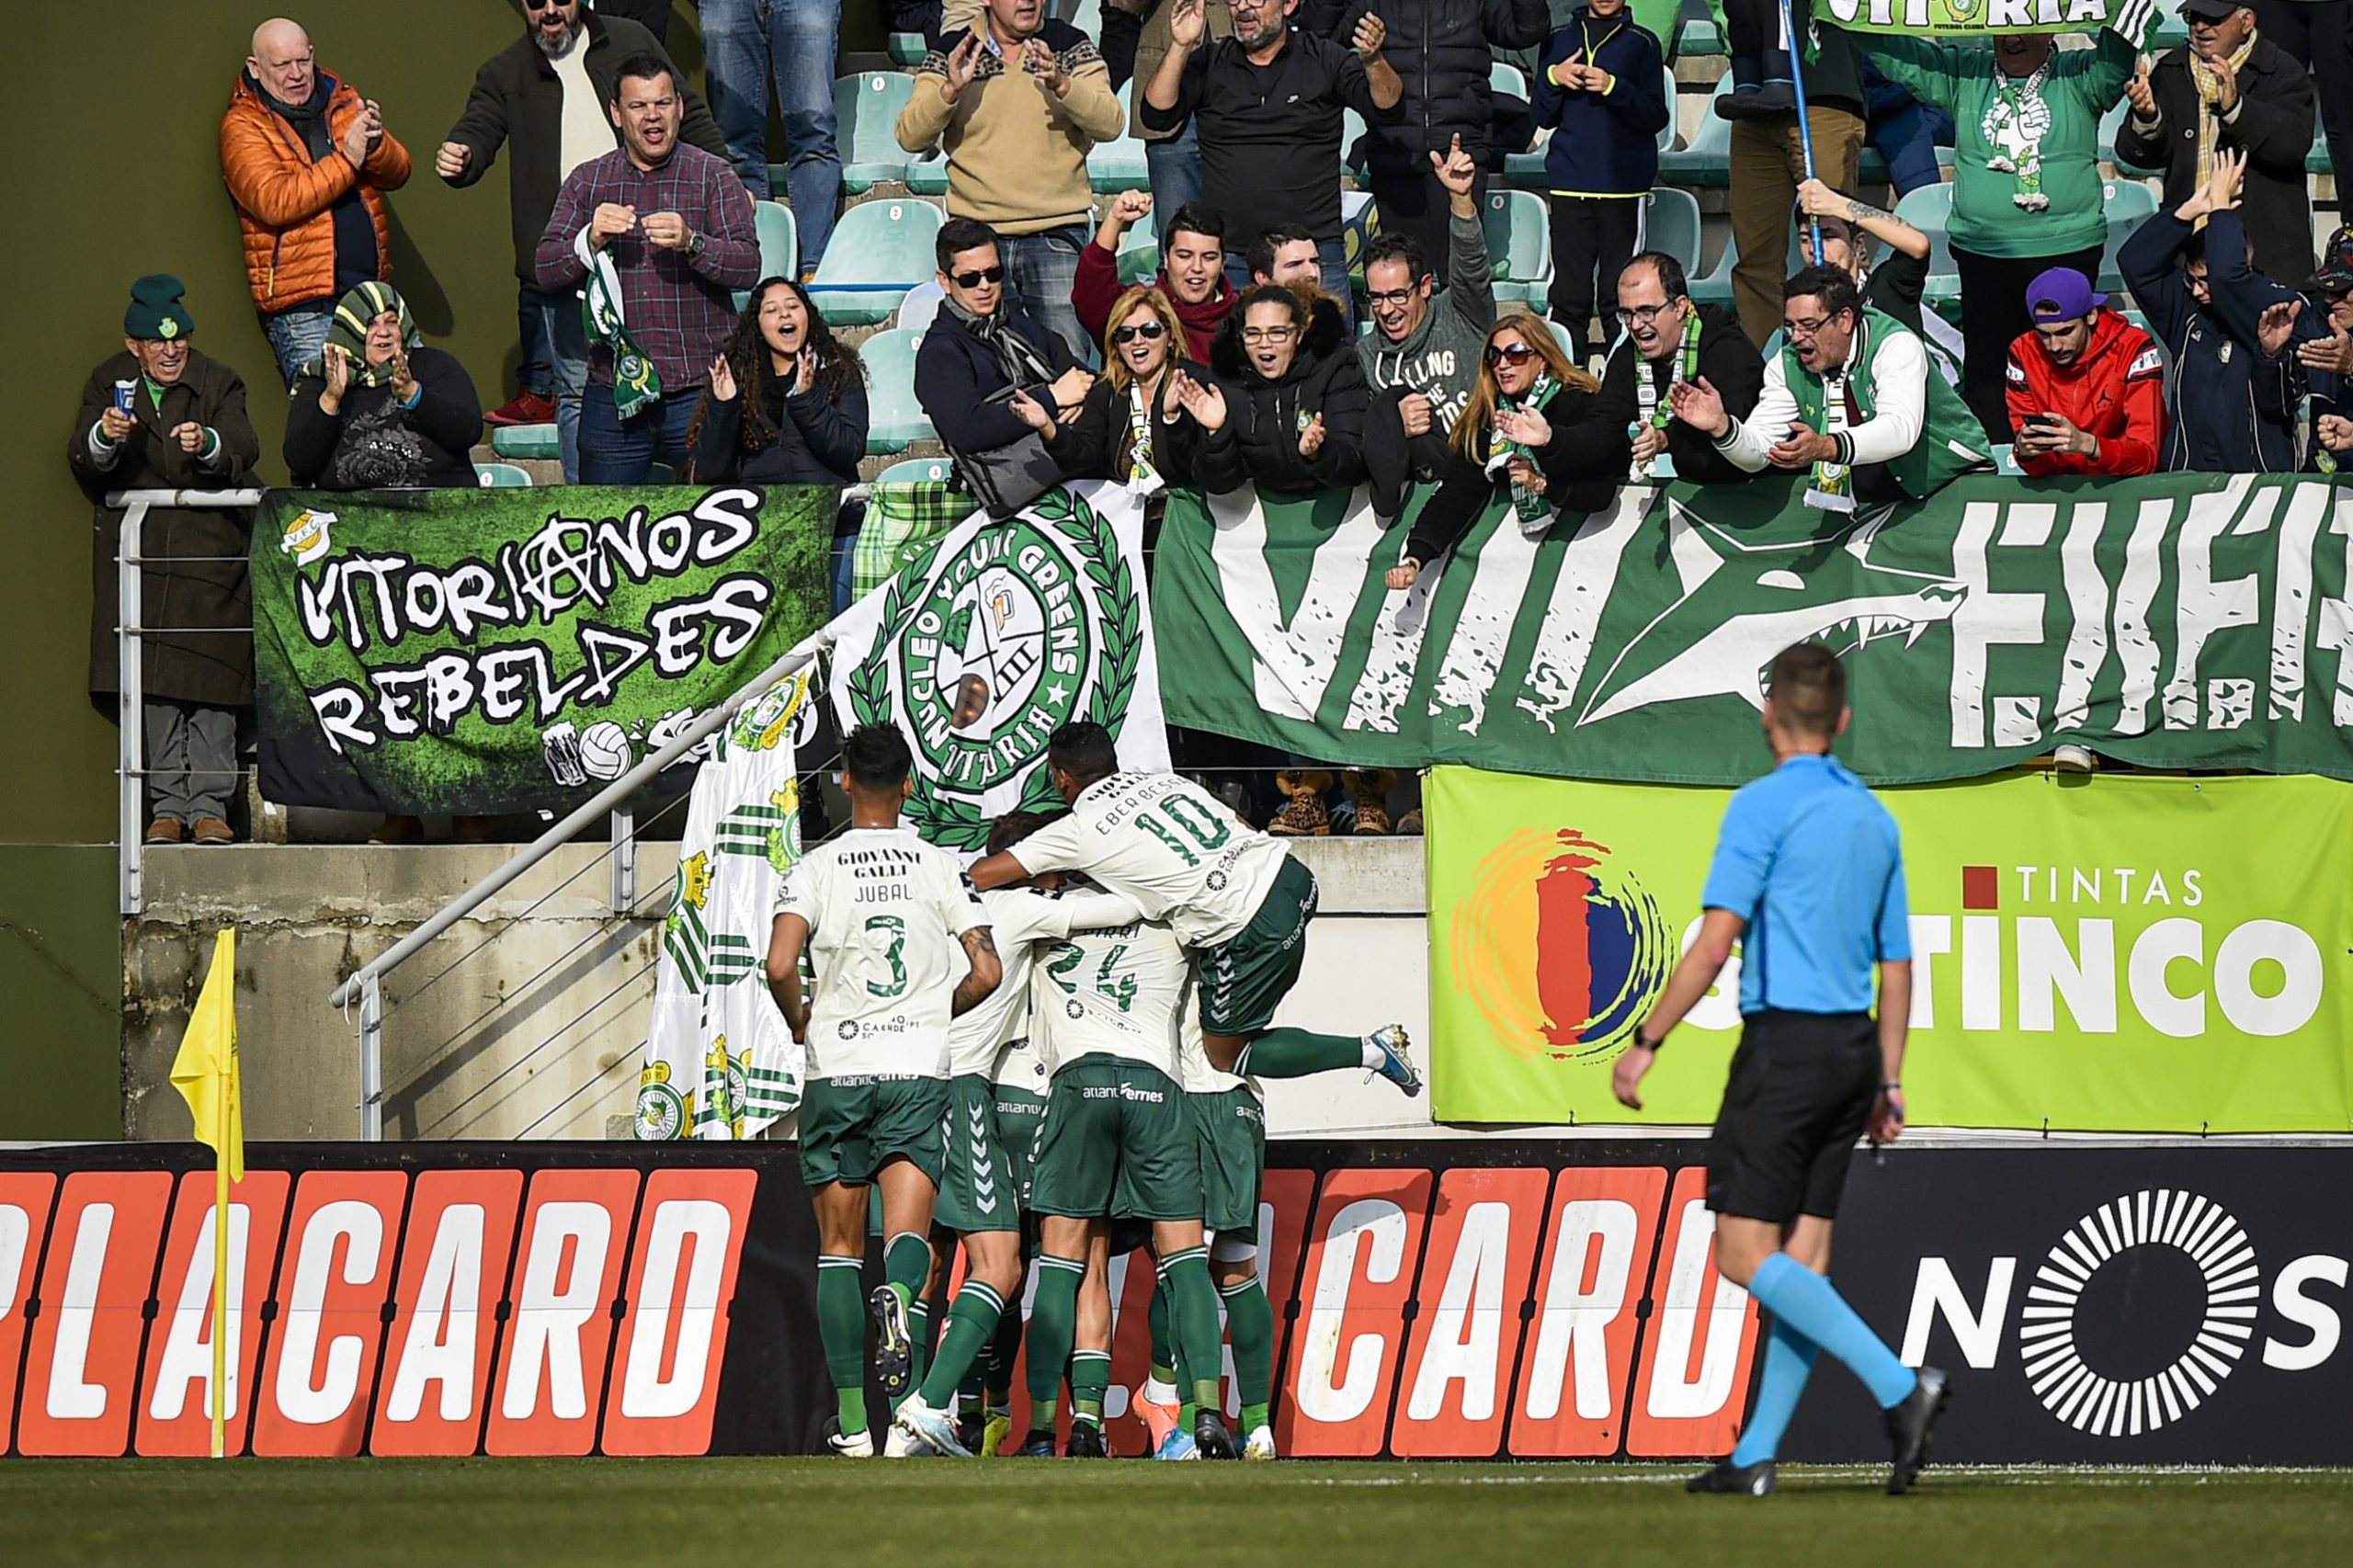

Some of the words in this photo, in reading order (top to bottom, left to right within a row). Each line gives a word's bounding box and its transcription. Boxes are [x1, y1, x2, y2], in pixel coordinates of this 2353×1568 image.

[1815, 0, 2108, 25] VITRIA
[1017, 544, 1079, 676] GREENS
[310, 578, 769, 754] REBELDES
[1095, 797, 1140, 835] EBER
[1134, 793, 1232, 868] 10
[837, 847, 920, 866] GIOVANNI
[854, 865, 906, 879] GALLI
[2016, 865, 2204, 905] TINTAS
[855, 883, 913, 903] JUBAL
[865, 915, 908, 997] 3
[1047, 941, 1138, 1013] 24
[1680, 915, 2325, 1040] STINCO
[1901, 1188, 2348, 1437] NOS
